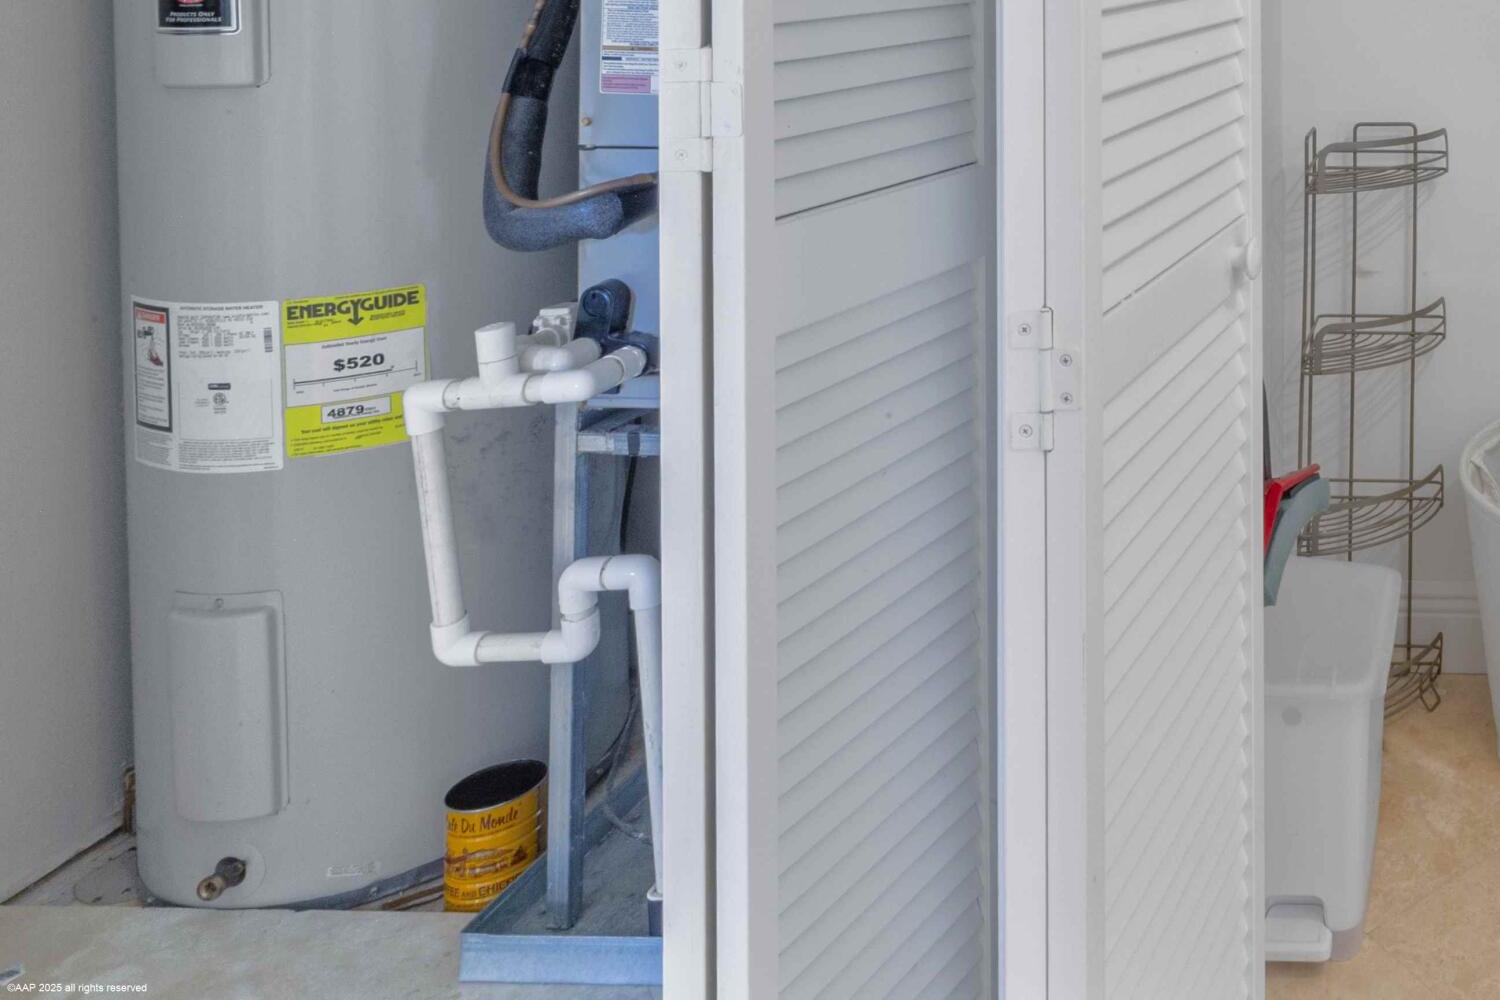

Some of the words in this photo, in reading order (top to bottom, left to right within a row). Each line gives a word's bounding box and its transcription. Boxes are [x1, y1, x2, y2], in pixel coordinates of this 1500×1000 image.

[286, 290, 420, 323] ENERGYGUIDE
[333, 353, 385, 373] $520
[327, 404, 365, 419] 4879
[461, 818, 475, 833] Du
[480, 807, 519, 830] Monde
